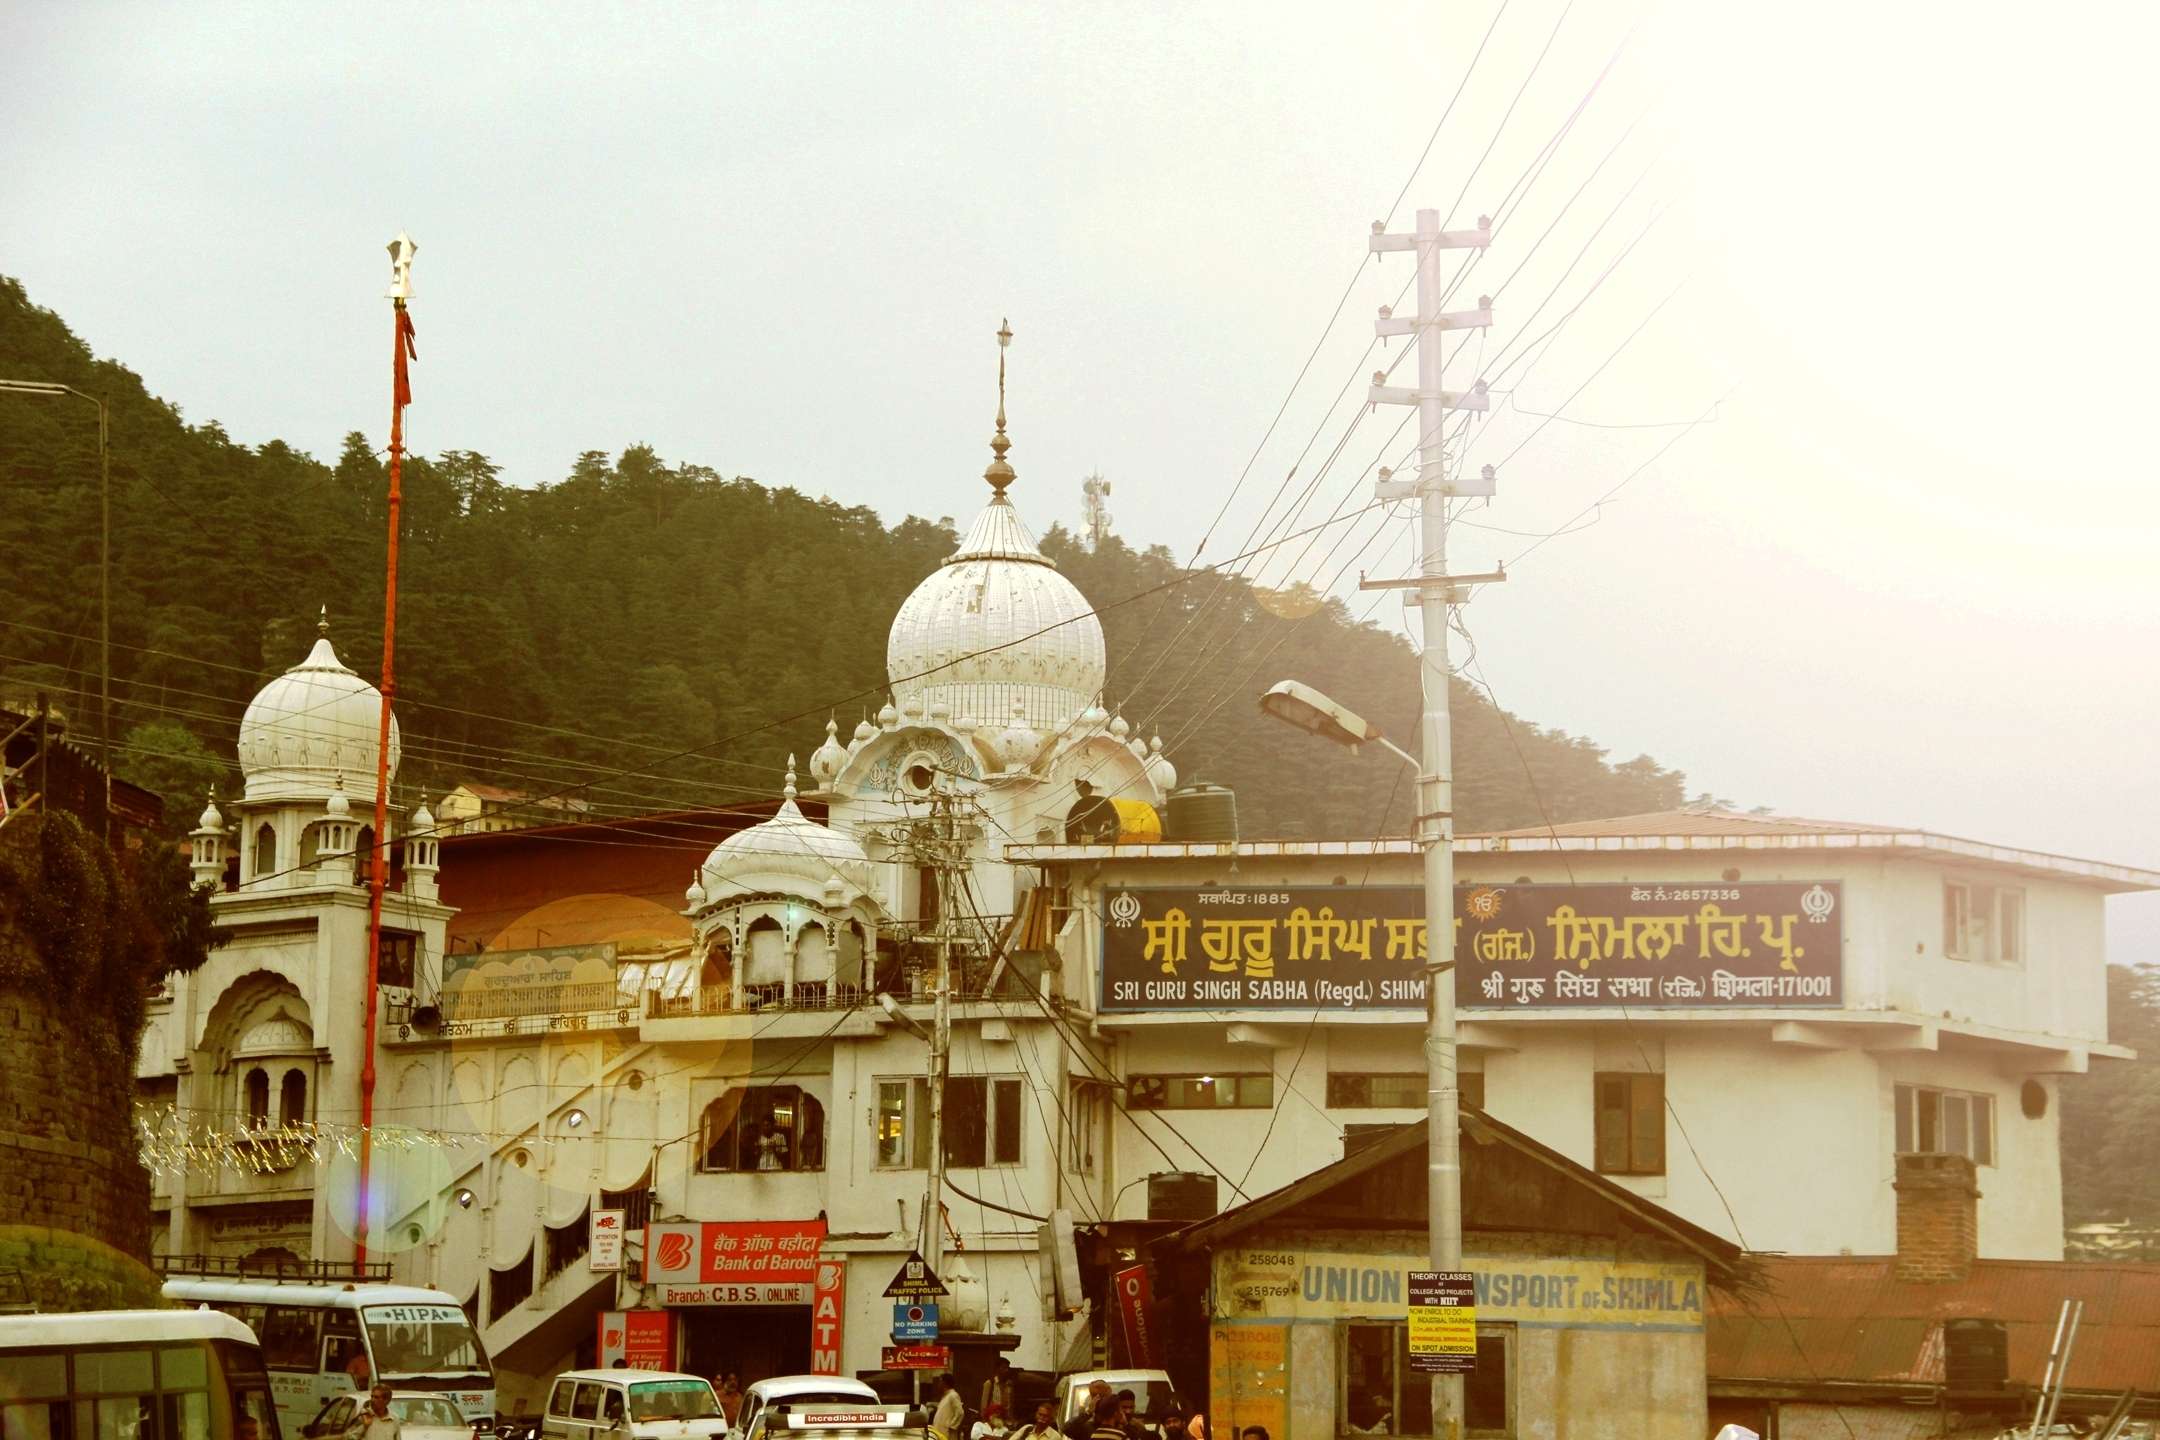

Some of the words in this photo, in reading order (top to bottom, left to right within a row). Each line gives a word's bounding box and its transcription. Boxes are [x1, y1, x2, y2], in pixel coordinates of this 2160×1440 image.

[1200, 918, 1277, 977] ਗੁਰੂ
[1284, 906, 1377, 961] ਸਿੰਘ
[1114, 981, 1139, 1000] SRI
[1146, 981, 1187, 1000] GURU
[1193, 981, 1241, 1000] SINGH
[1248, 980, 1308, 1000] SABHA
[1314, 979, 1374, 1006] (Regd.)
[1380, 980, 1429, 1000] SHIM
[1481, 970, 1504, 999] श्री
[1554, 970, 1601, 999] सिंघ
[1608, 977, 1653, 999] सभा
[713, 1254, 751, 1271] Bank
[752, 1254, 769, 1271] of
[1249, 1254, 1295, 1266] 258048
[1440, 1273, 1472, 1281] CLASSES
[1303, 1265, 1400, 1304] UNION
[1602, 1275, 1701, 1312] SHIMLA
[392, 1308, 444, 1321] HIPA
[814, 1296, 838, 1373] ATM
[629, 1361, 662, 1371] ATM
[808, 1414, 857, 1423] Incredible
[859, 1413, 884, 1422] India
